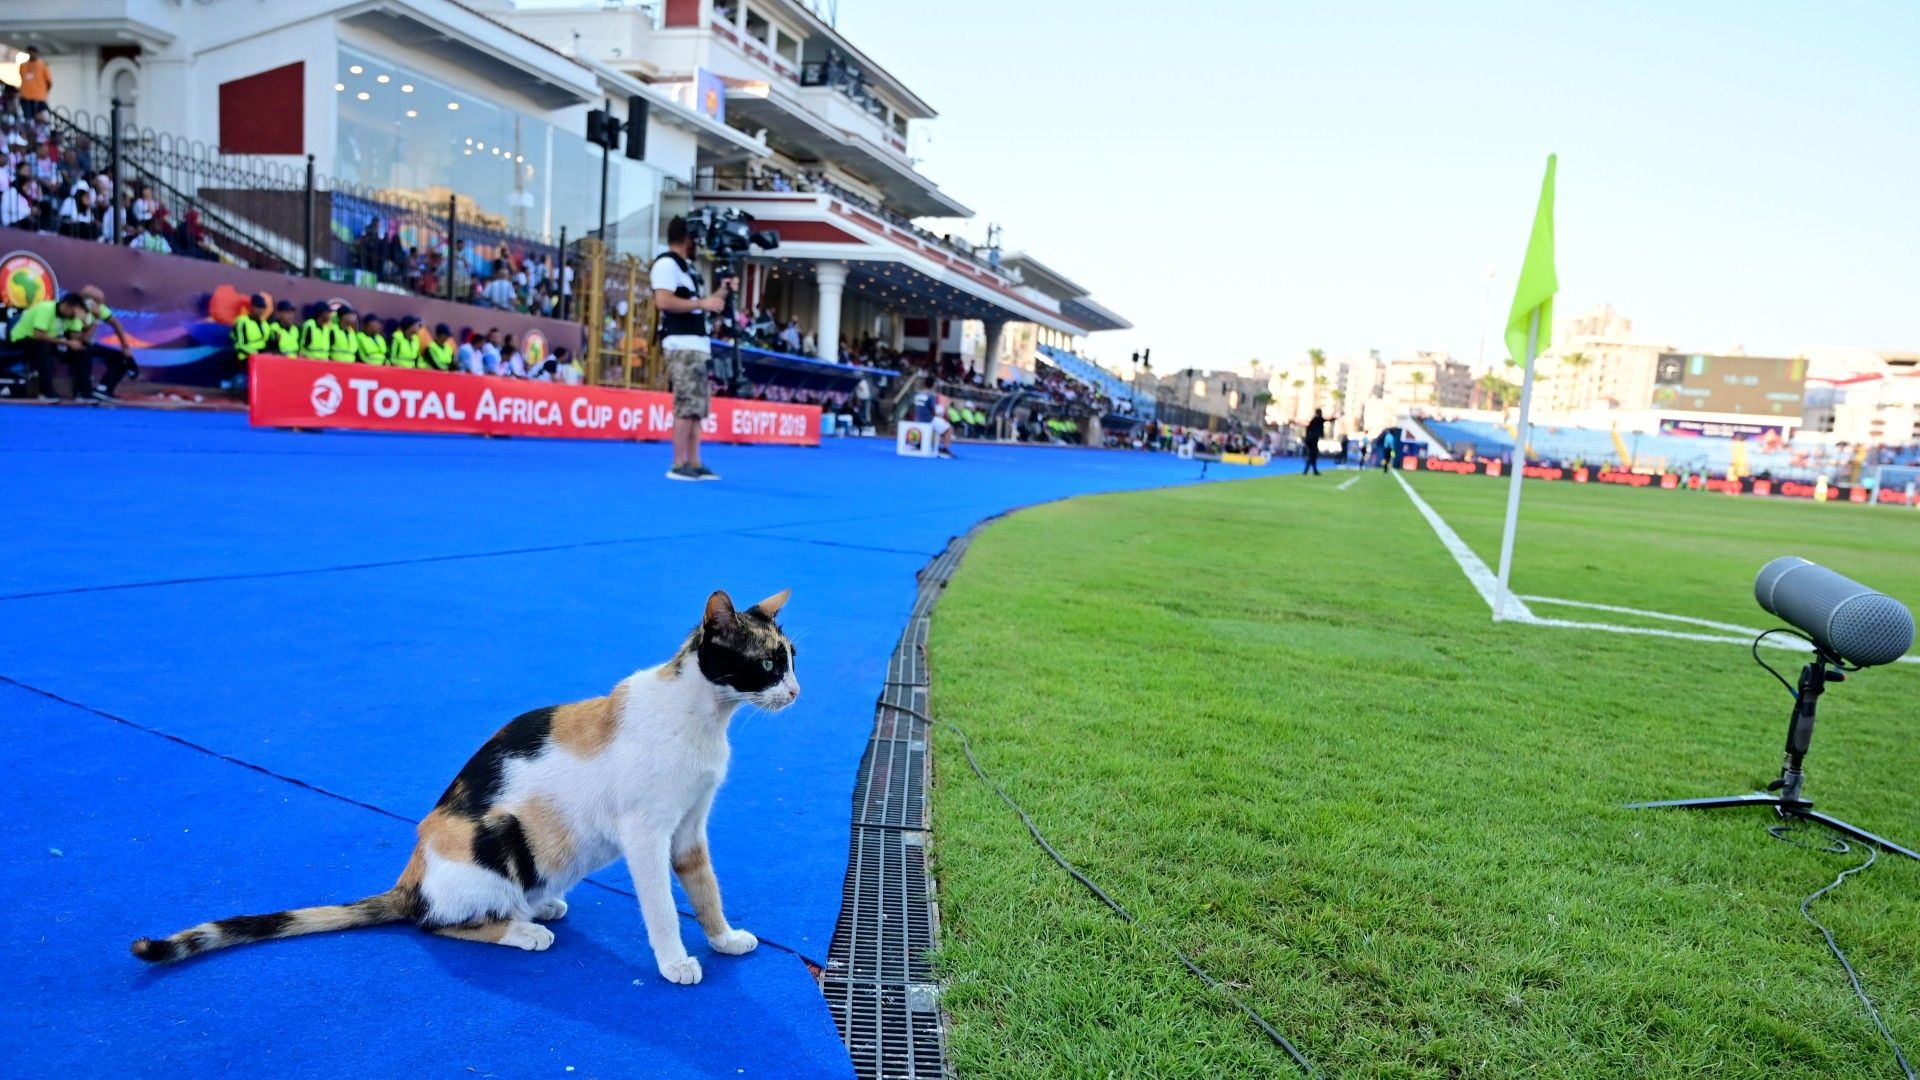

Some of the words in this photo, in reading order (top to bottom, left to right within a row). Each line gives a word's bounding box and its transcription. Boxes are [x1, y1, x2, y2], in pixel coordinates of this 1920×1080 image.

[348, 378, 465, 420] TOTAL
[475, 388, 563, 426] AFRICA
[570, 397, 613, 429] CUP
[618, 407, 643, 430] OF
[648, 404, 718, 433] NANS
[731, 409, 778, 434] EGYPT
[778, 413, 807, 436] 2019
